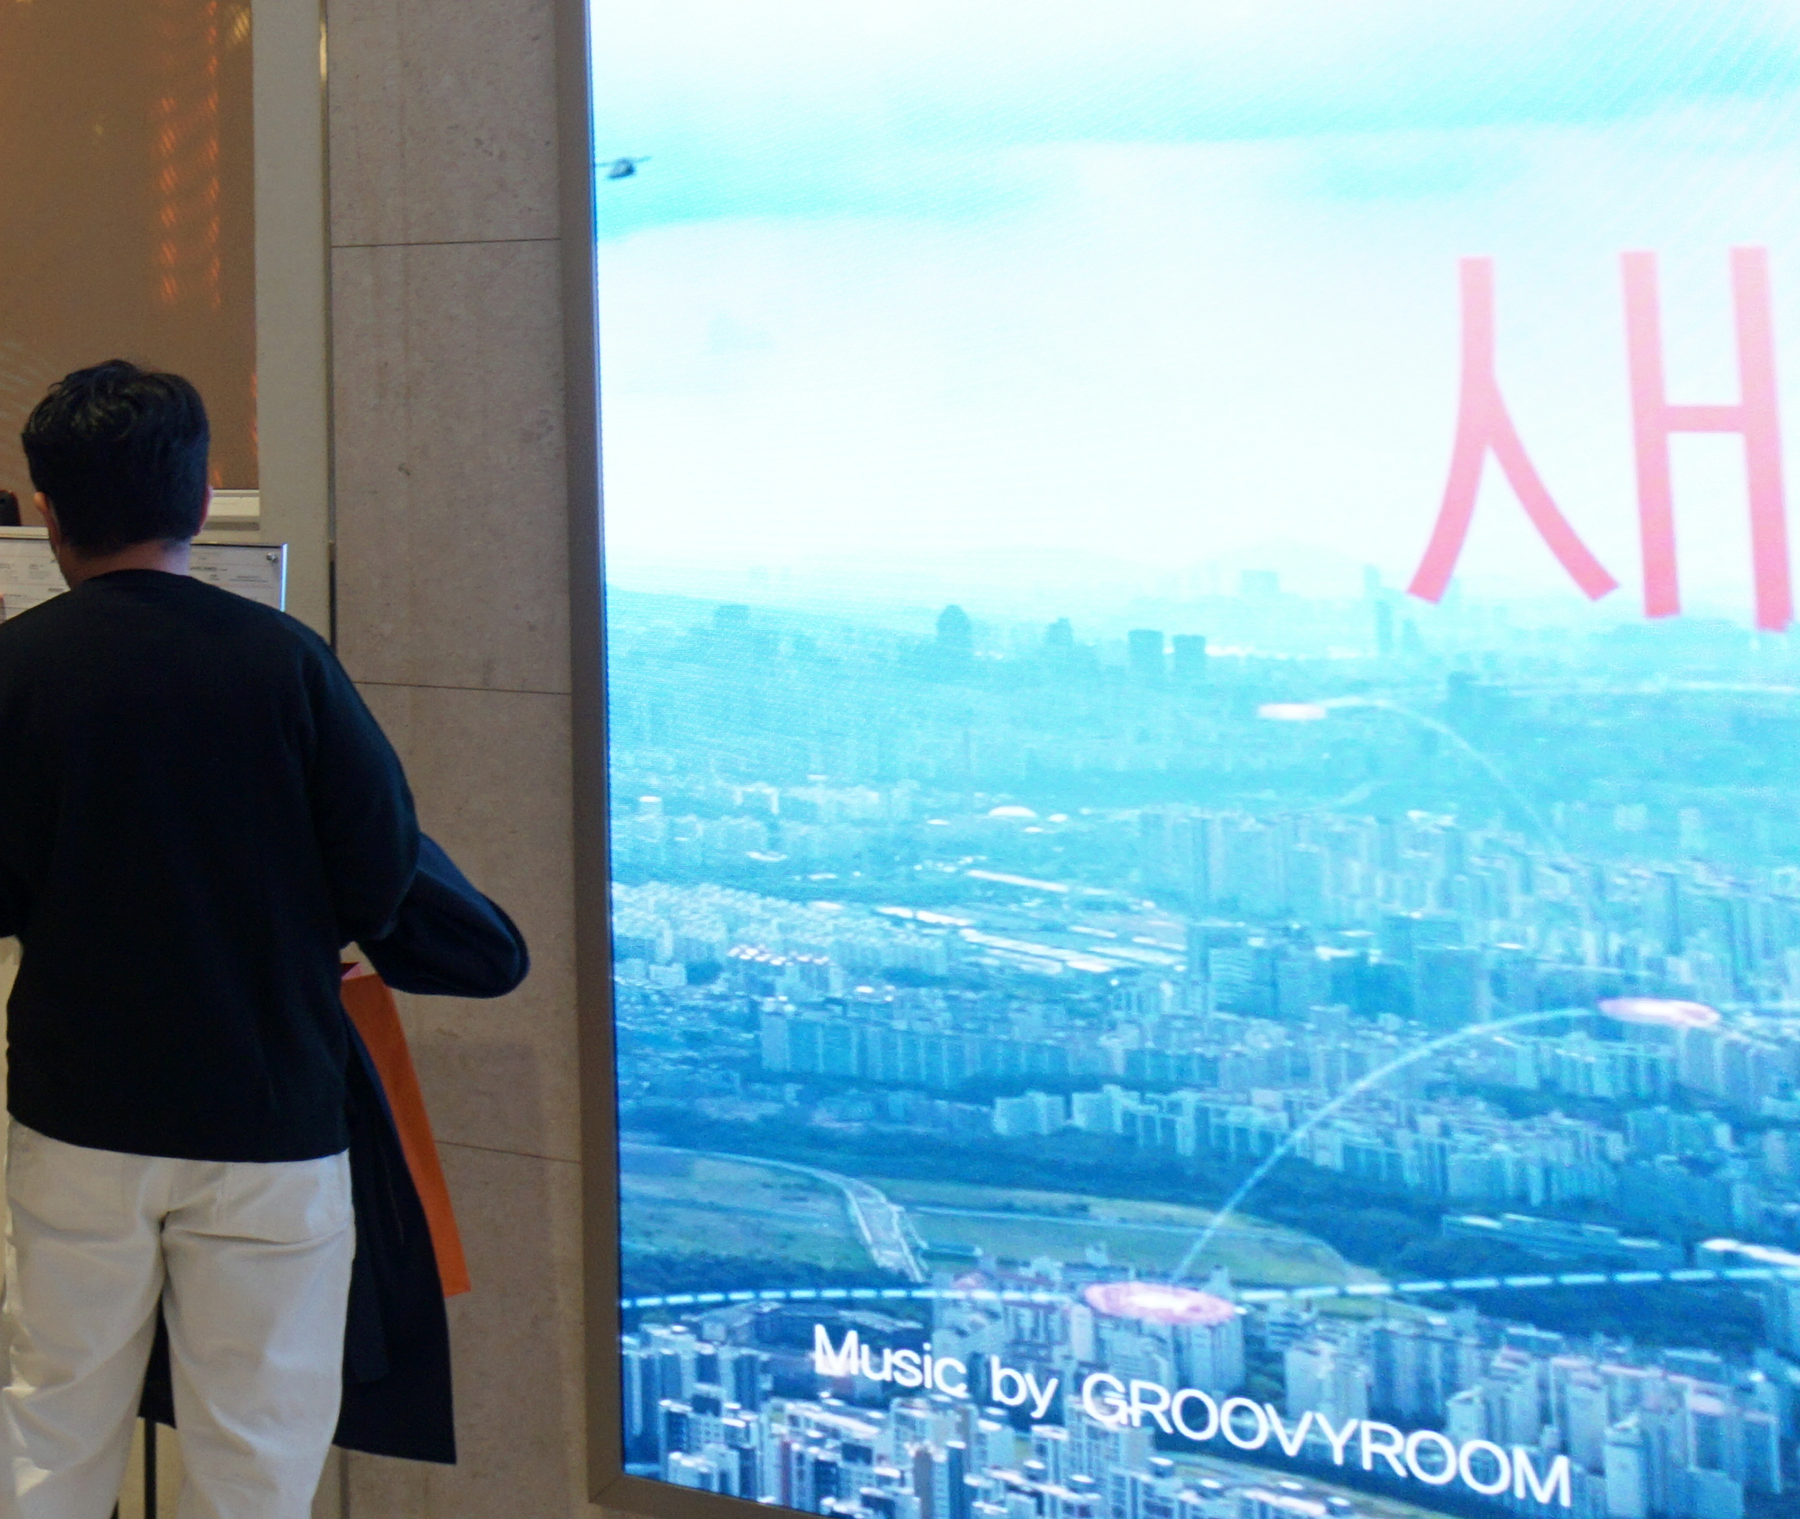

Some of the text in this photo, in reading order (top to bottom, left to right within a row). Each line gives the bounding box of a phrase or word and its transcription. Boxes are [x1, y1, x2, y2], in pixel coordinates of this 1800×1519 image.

[1405, 245, 1795, 634] 새
[813, 1323, 1572, 1508] Music by GROOVYROOM
